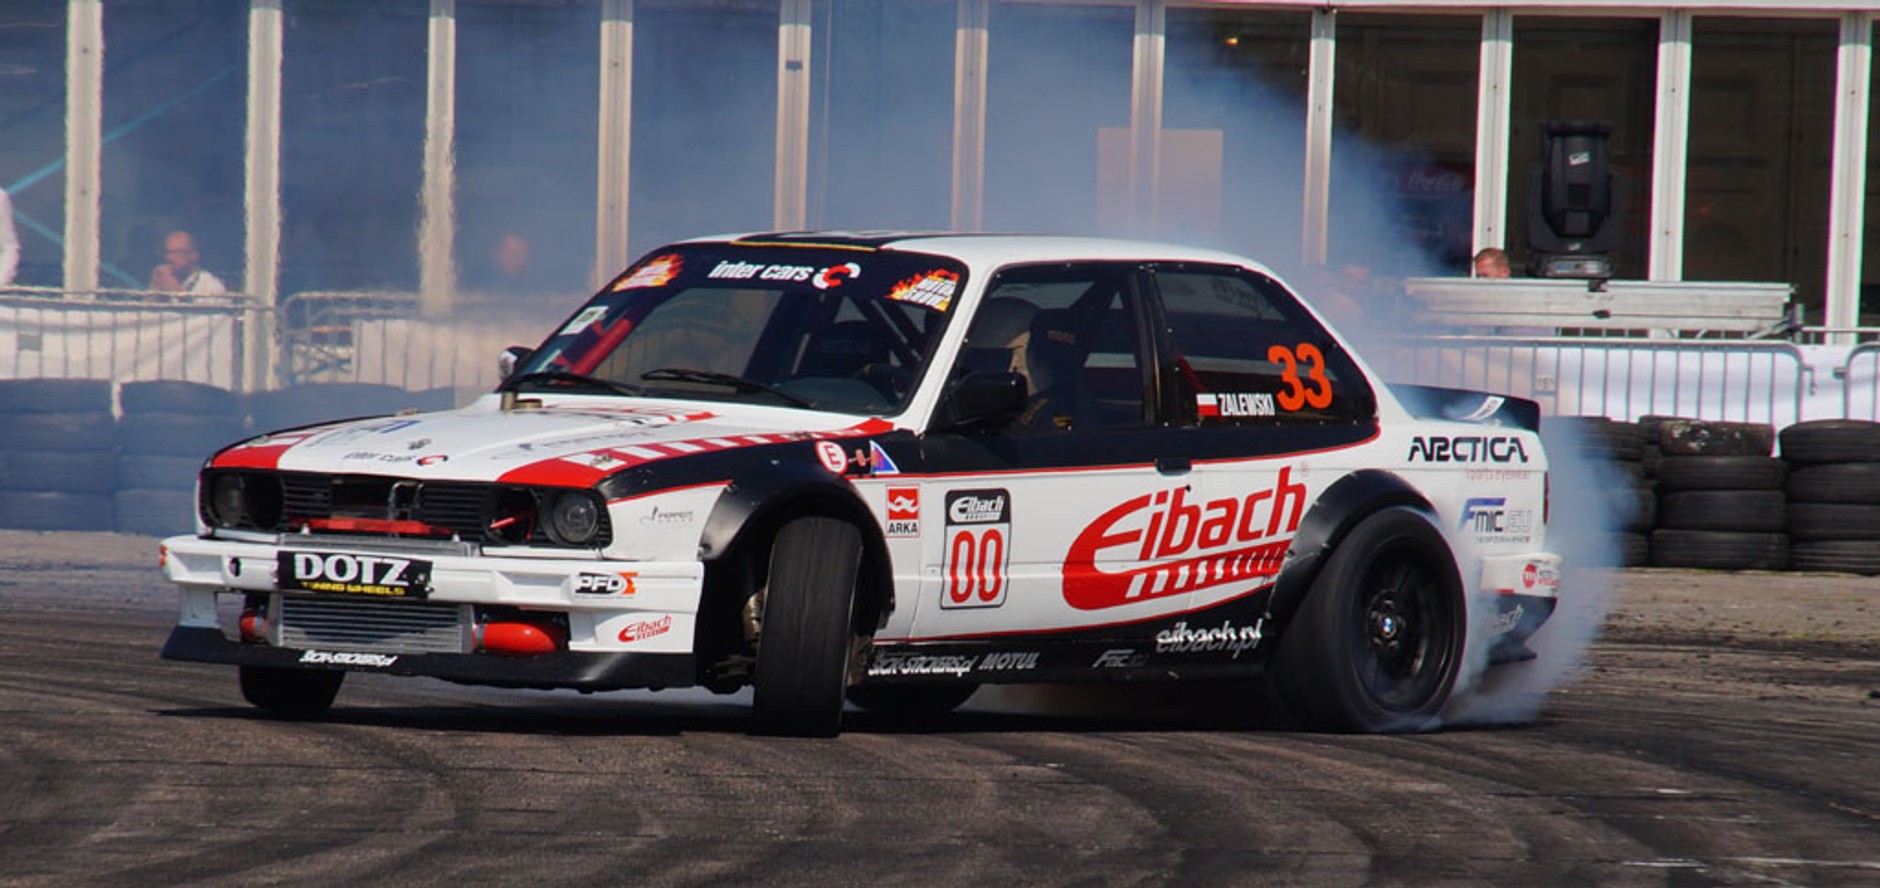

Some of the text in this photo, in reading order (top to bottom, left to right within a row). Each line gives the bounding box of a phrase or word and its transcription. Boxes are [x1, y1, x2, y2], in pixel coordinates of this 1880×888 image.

[707, 260, 814, 281] inter cars
[1267, 342, 1333, 411] 33
[1217, 392, 1276, 417] ZALEWSKI
[1407, 435, 1529, 463] ARCTICA
[951, 496, 1006, 523] Eibach
[888, 521, 918, 535] ARKA
[1062, 465, 1308, 611] Eibach
[294, 552, 411, 587] DOTZ
[950, 528, 1004, 603] 00
[618, 613, 672, 643] Eibach
[979, 651, 1040, 671] MOTUL
